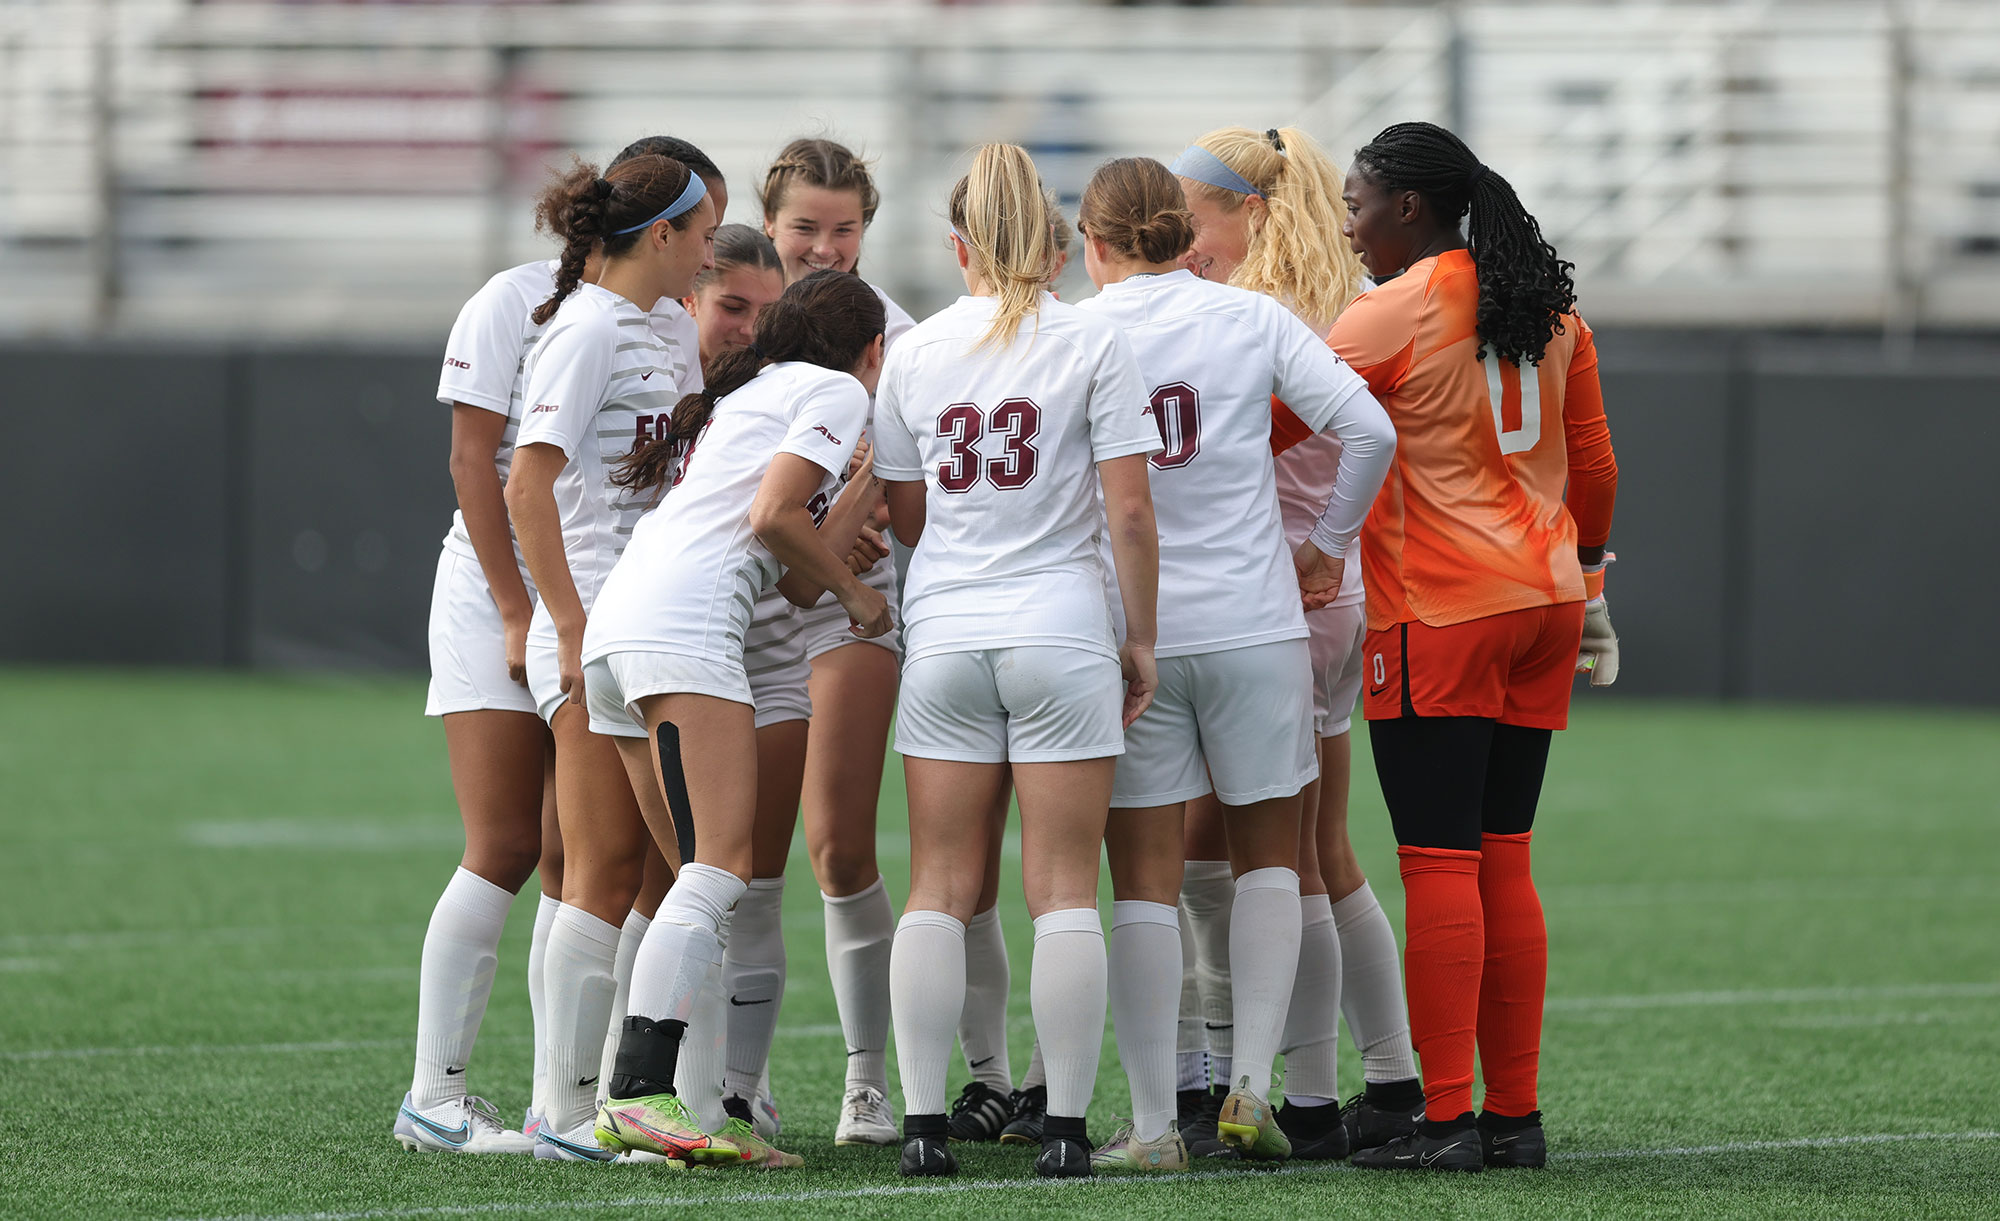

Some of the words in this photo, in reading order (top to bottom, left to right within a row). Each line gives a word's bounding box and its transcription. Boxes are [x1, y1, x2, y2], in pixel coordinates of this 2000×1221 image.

[443, 357, 471, 370] A10
[531, 404, 560, 413] A10
[812, 424, 842, 446] A10
[936, 397, 1042, 494] 33
[1373, 653, 1385, 685] 0
